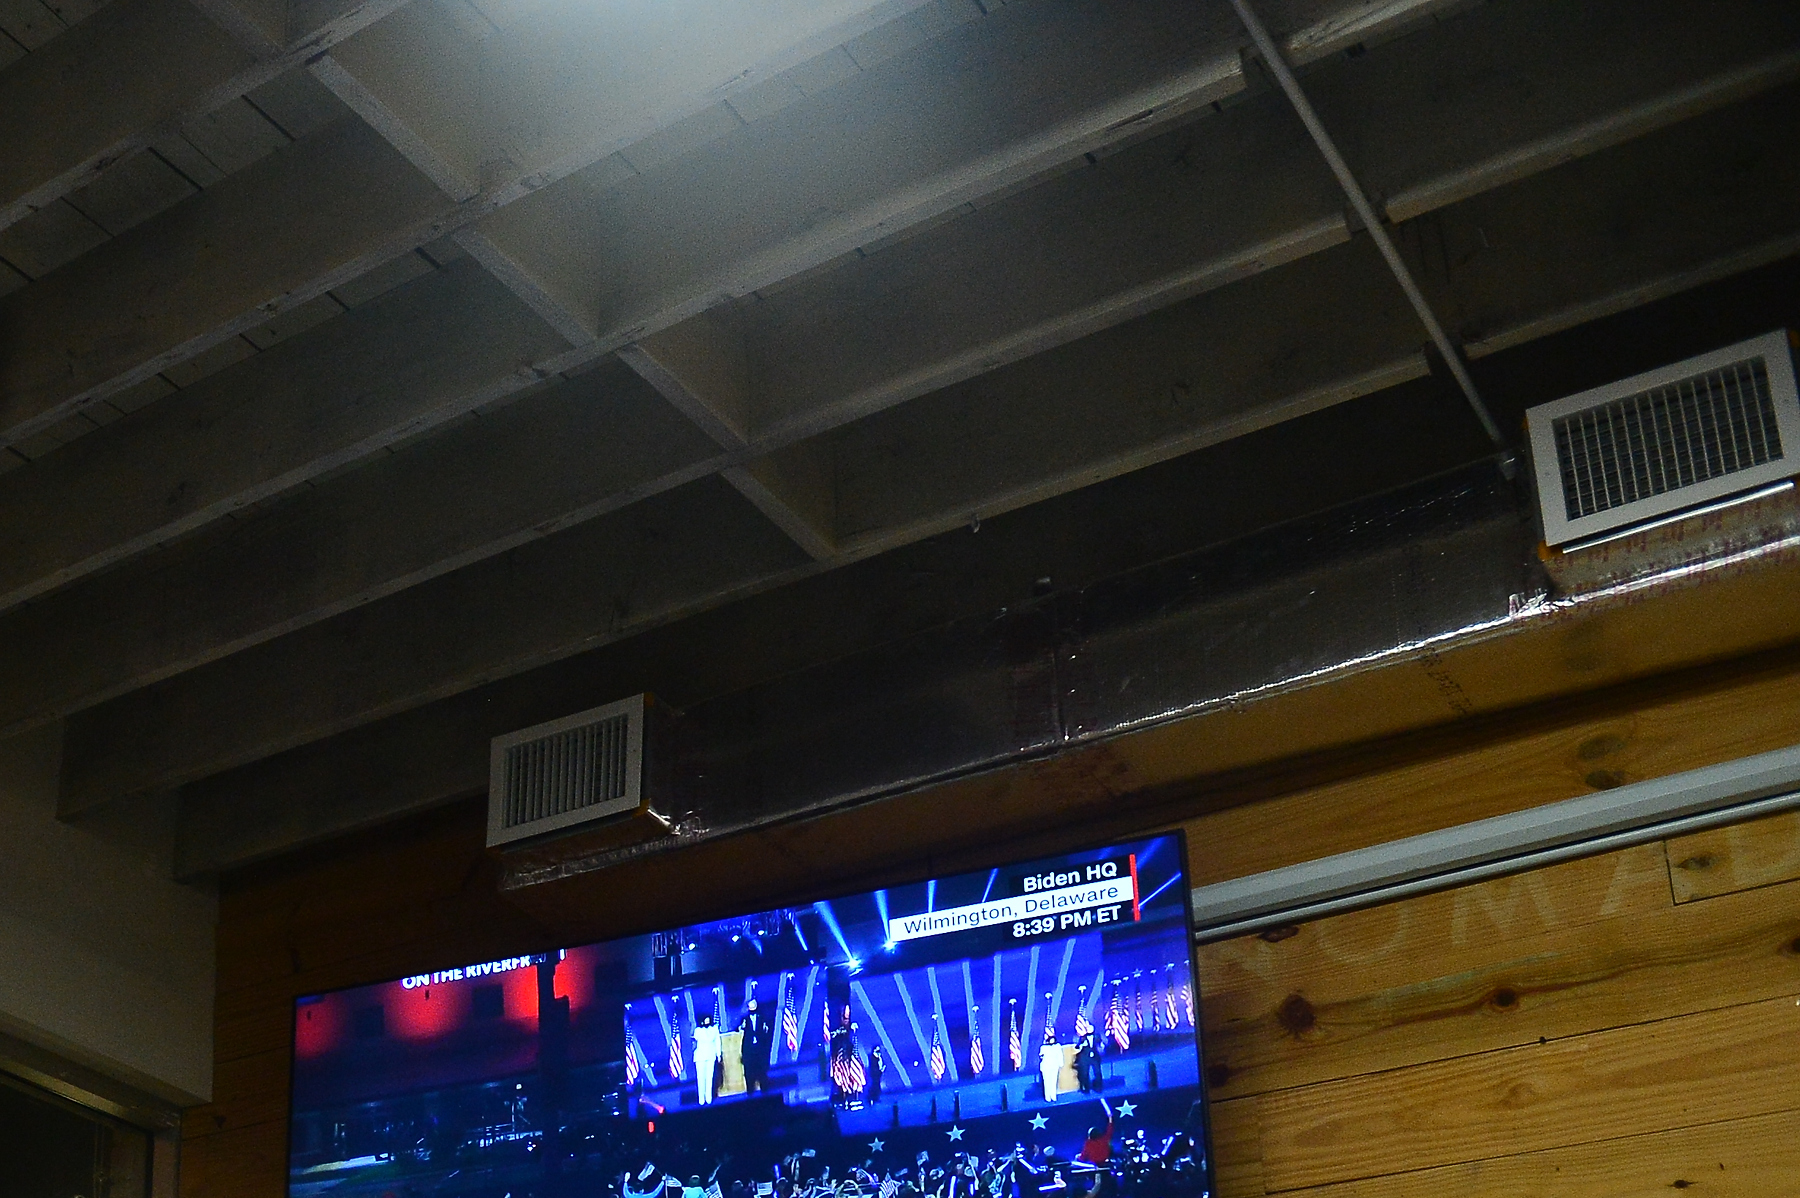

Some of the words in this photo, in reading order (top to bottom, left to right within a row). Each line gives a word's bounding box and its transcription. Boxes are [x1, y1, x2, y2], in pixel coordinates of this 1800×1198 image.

[1023, 866, 1081, 893] Biden
[1086, 861, 1118, 881] HQ
[903, 904, 1019, 935] Wilmington,
[1024, 884, 1119, 914] Delaware
[1012, 915, 1055, 938] 8:39
[1060, 911, 1093, 930] PM
[1096, 905, 1122, 923] ET
